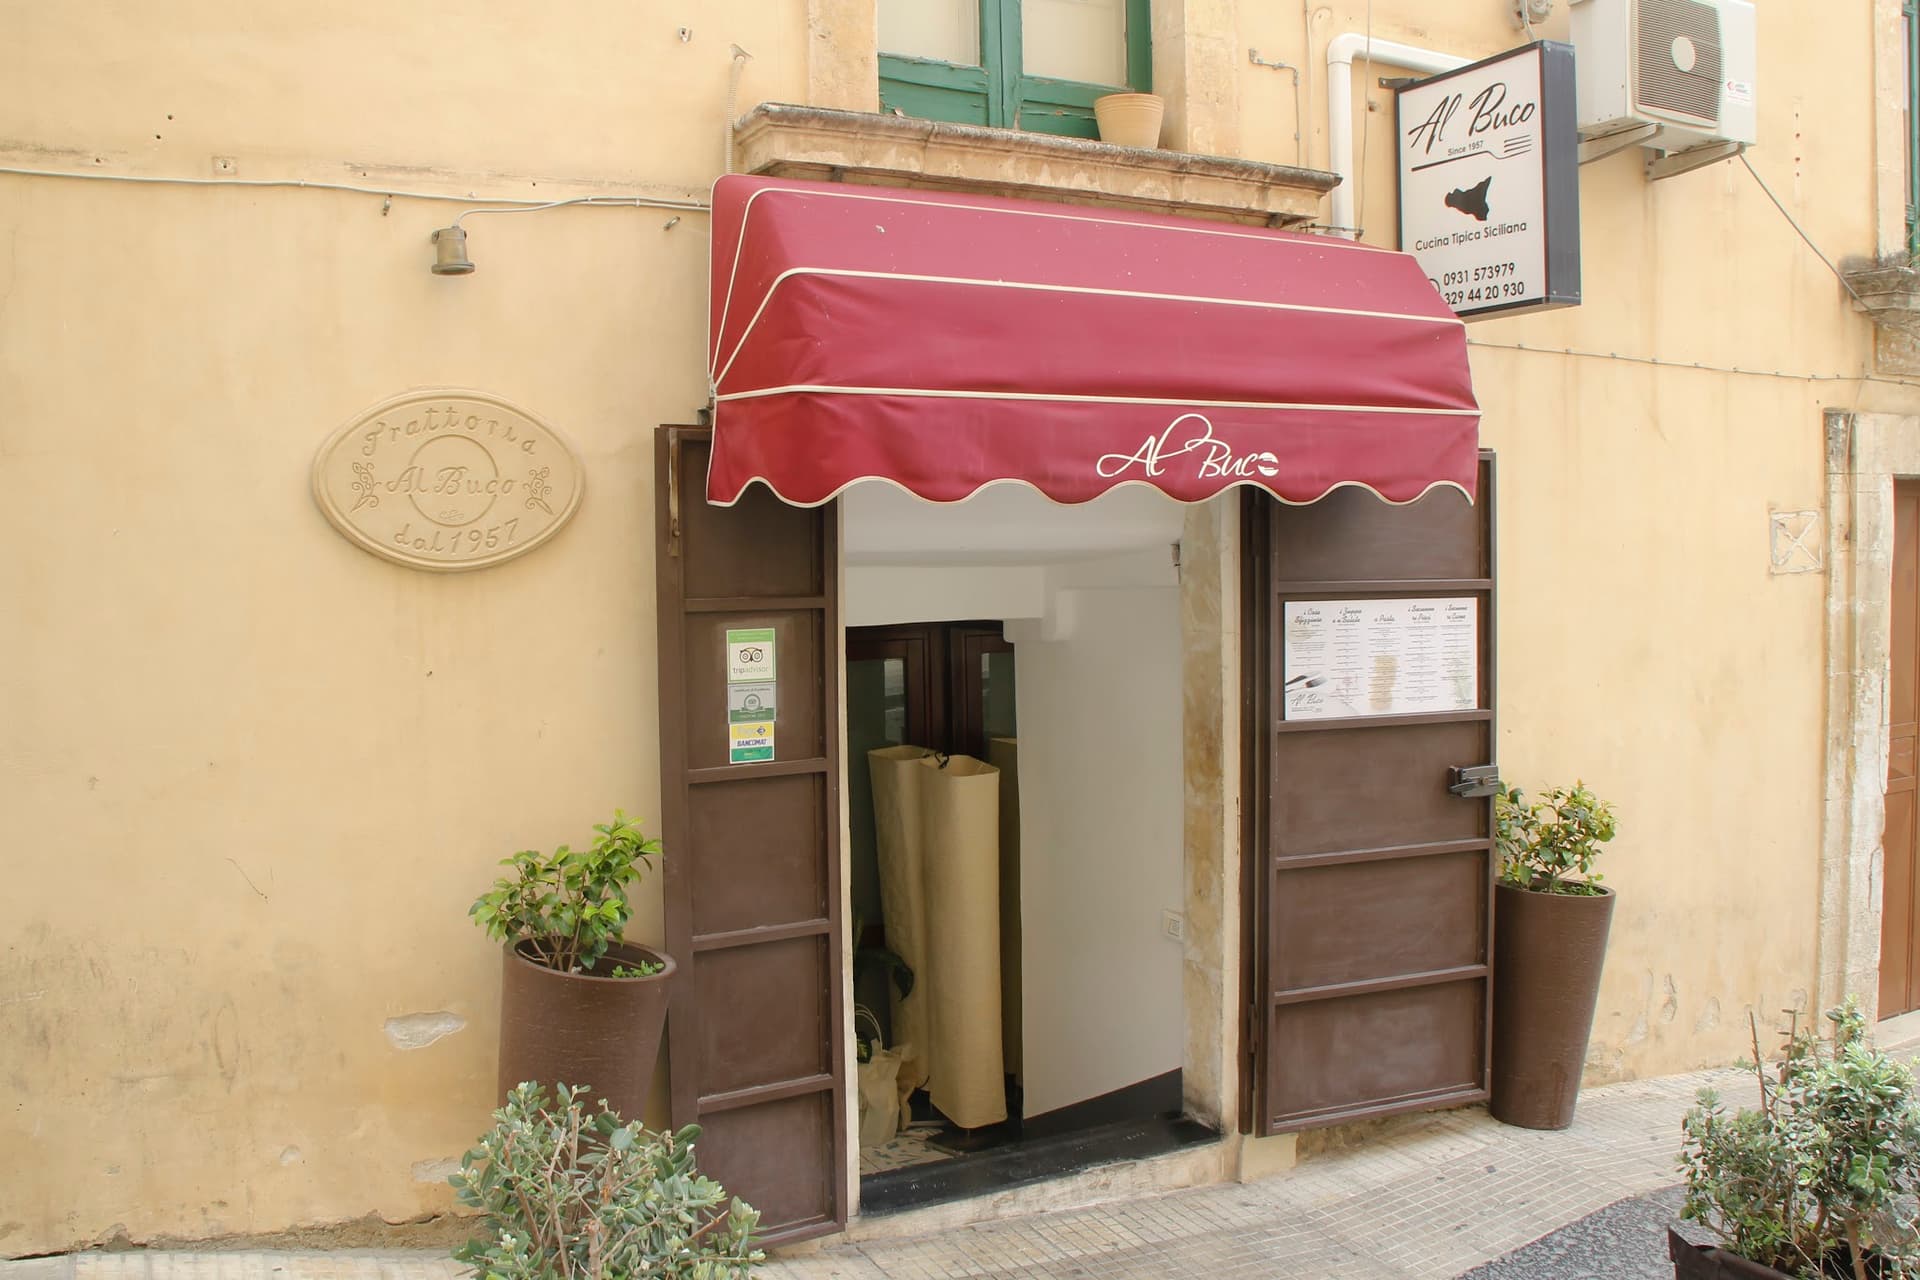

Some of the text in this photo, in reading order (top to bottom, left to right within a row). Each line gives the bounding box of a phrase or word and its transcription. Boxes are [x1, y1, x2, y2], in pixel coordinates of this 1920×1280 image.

[1408, 82, 1535, 154] Al Buco
[1448, 140, 1484, 156] Since 1957
[1415, 222, 1527, 251] Cucina Tipica Siciliana
[1443, 262, 1515, 286] 0931 573979
[1444, 281, 1525, 305] 329 44 20 930
[362, 406, 537, 457] Trattoria
[1096, 413, 1214, 478] Al
[385, 466, 516, 495] Al Buco
[394, 517, 520, 554] dal 1957
